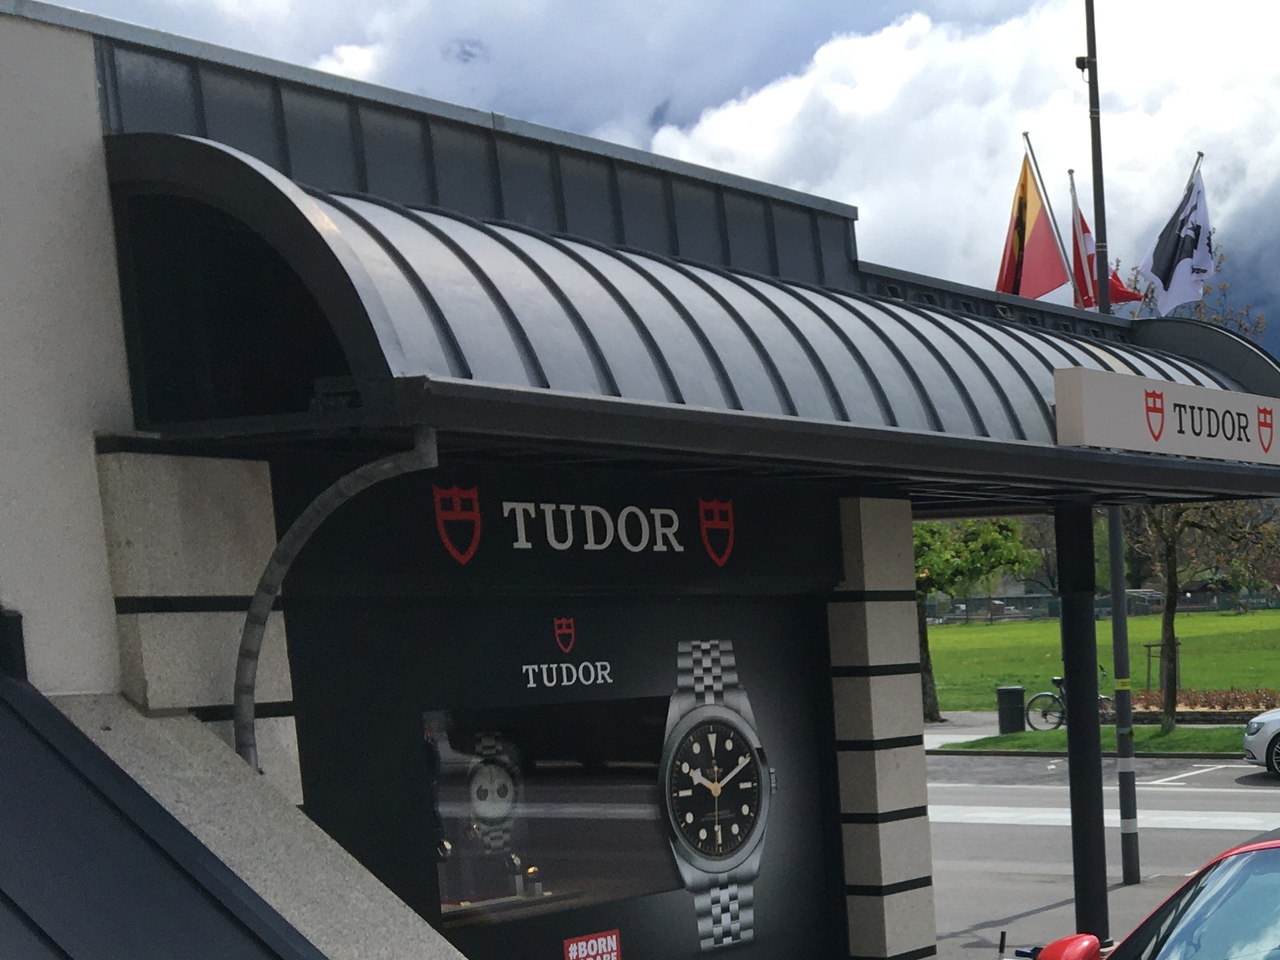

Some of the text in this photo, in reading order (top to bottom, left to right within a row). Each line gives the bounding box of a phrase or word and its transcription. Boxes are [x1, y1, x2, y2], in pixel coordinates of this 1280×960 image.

[1173, 402, 1251, 443] TUDOR
[502, 501, 684, 553] TUDOR
[522, 661, 614, 688] TUDOR
[568, 934, 618, 960] #BORN
